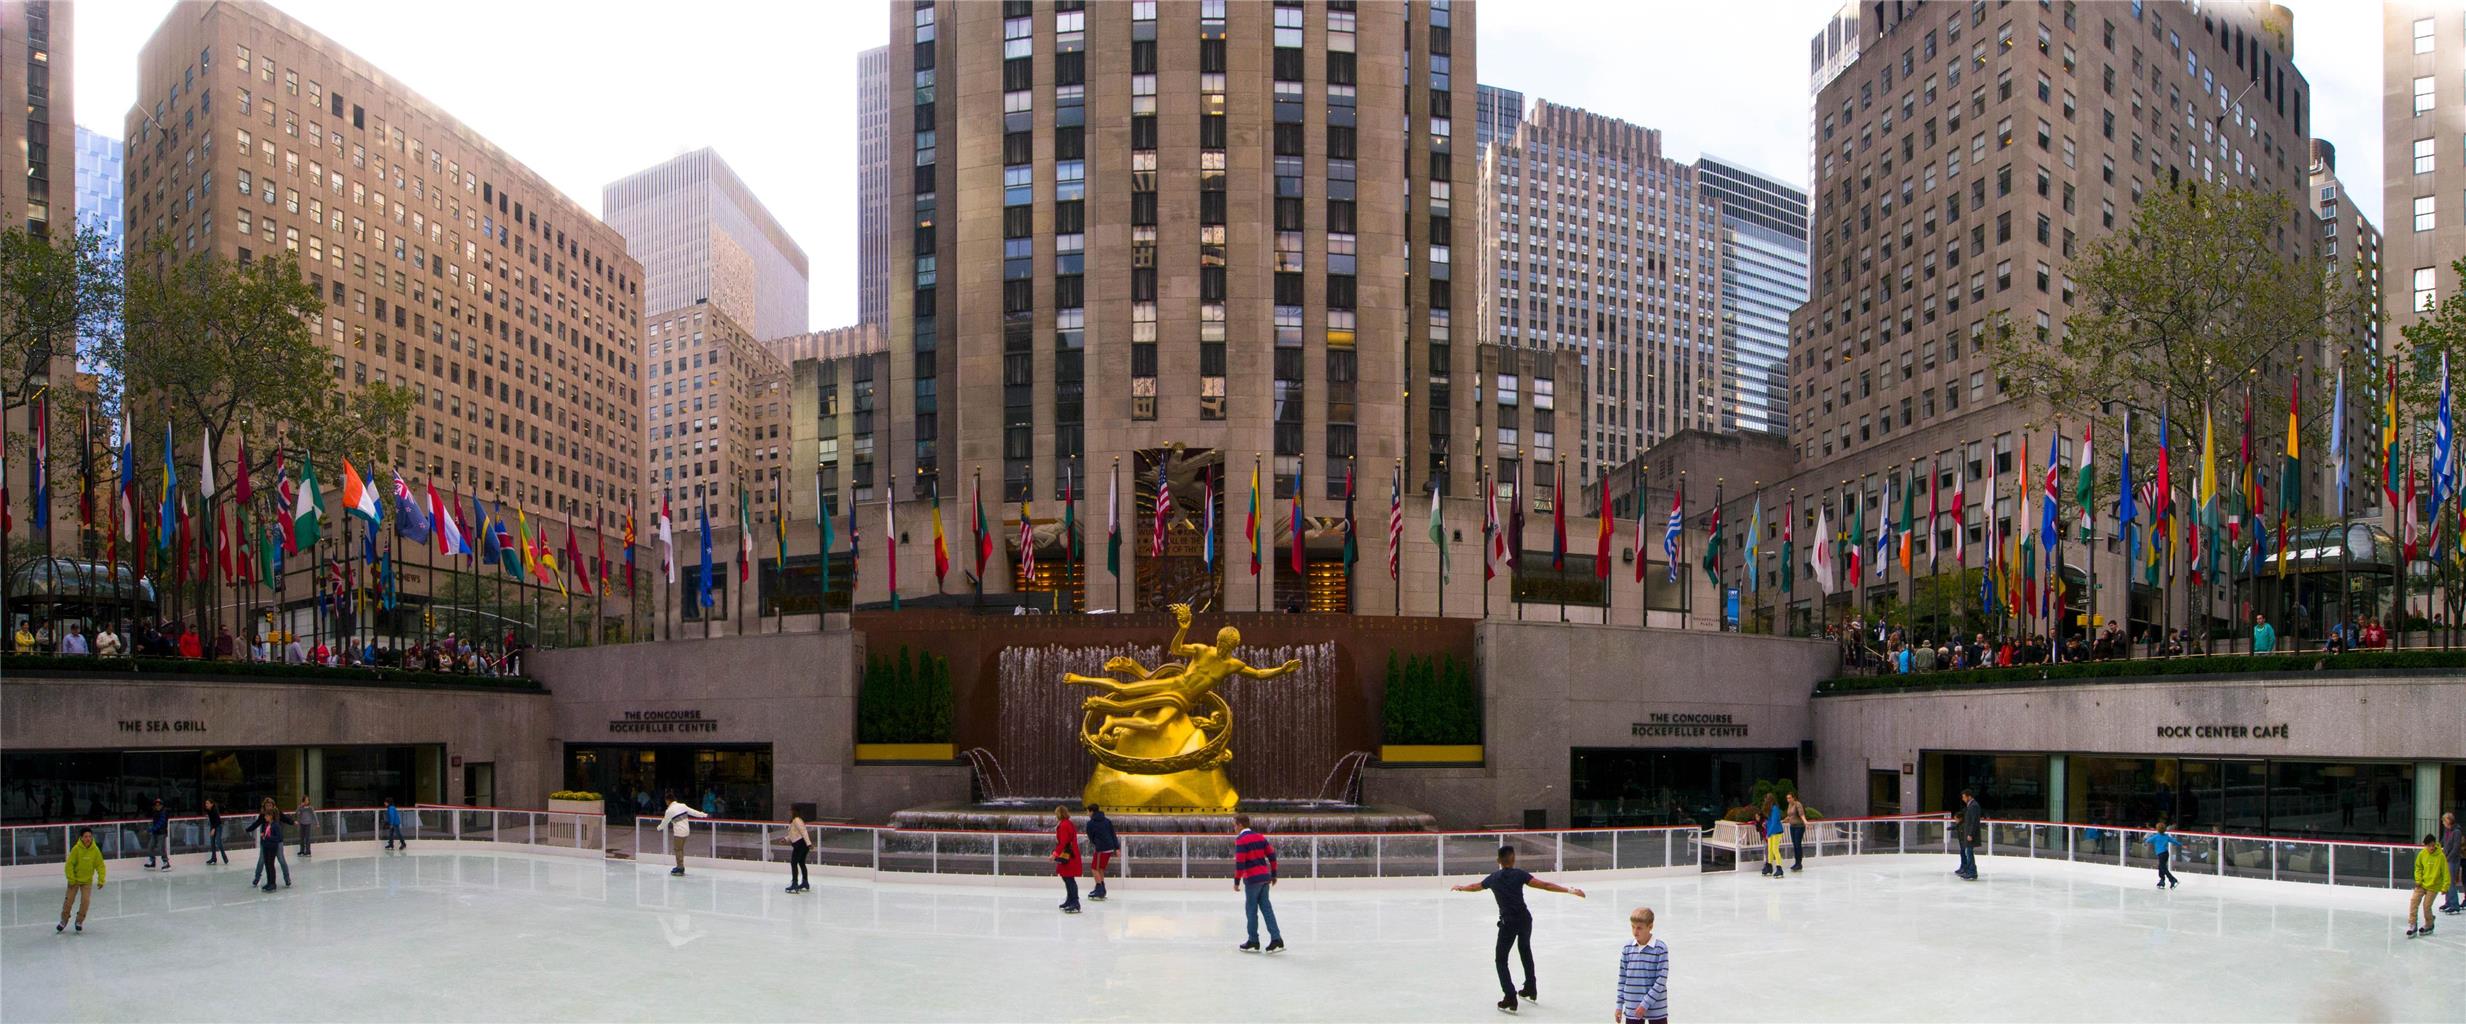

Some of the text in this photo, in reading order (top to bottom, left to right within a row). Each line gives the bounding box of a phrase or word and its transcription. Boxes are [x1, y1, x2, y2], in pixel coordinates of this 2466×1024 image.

[624, 710, 701, 720] THE CONCOURSE
[1649, 713, 1733, 723] THE CONCOURSE
[118, 720, 207, 732] THE SEA GRILL
[609, 723, 718, 733] ROCKEFELLER CENTER
[2157, 723, 2289, 738] ROCK CENTER CAFÉ
[1631, 726, 1748, 737] ROCKEFELLER CENTER
